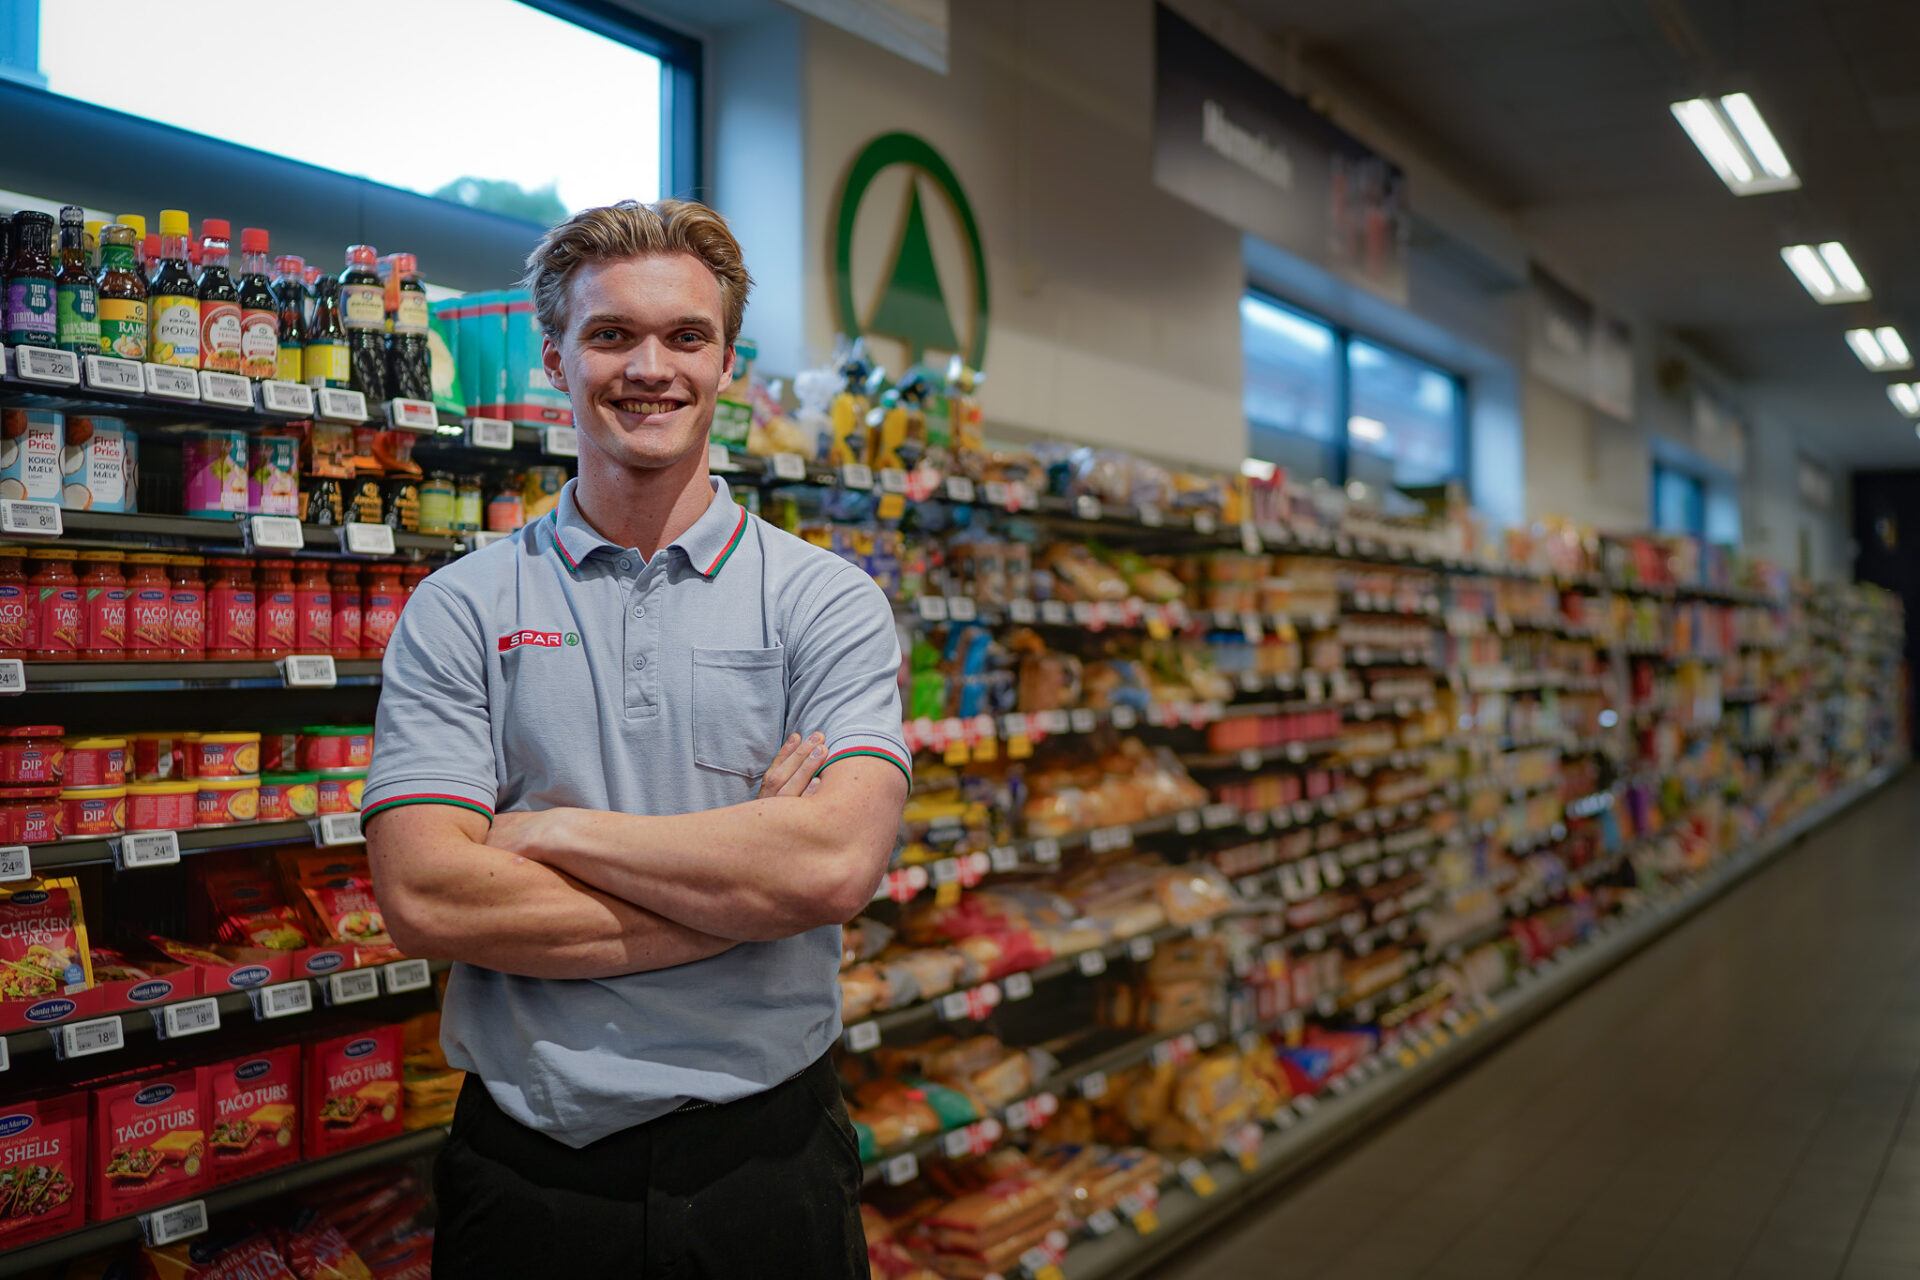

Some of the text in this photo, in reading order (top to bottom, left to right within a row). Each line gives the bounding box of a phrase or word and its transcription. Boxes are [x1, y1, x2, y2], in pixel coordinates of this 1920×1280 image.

[31, 297, 46, 308] ASIA
[28, 429, 54, 441] First
[28, 440, 56, 451] Price
[94, 436, 117, 447] First
[94, 446, 120, 457] Price
[28, 457, 56, 465] KOKOS
[93, 463, 120, 471] KOKOS
[28, 465, 54, 474] MÆLK
[93, 471, 117, 479] MÆLK
[0, 604, 23, 617] ACO
[133, 606, 168, 619] TACO
[0, 616, 17, 624] AUCE
[510, 632, 560, 647] SPAR
[22, 759, 42, 771] DIP
[203, 754, 224, 765] DIP
[109, 760, 122, 772] DIP
[18, 769, 44, 779] SALSA
[199, 800, 218, 811] DIP
[260, 795, 279, 807] DIP
[83, 810, 105, 822] DIP
[26, 820, 46, 831] DIP
[23, 830, 47, 840] SALSA
[0, 917, 70, 940] CHICKEN
[21, 931, 53, 946] TACO
[132, 988, 150, 996] Santa
[29, 1002, 71, 1017] Santa Maria
[328, 1061, 393, 1091] TACO TUBS
[217, 1083, 288, 1116] TACO TUBS
[9, 1117, 29, 1129] Maria
[116, 1118, 156, 1144] TACO
[158, 1109, 195, 1131] TUBS
[4, 1138, 60, 1165] SHELLS
